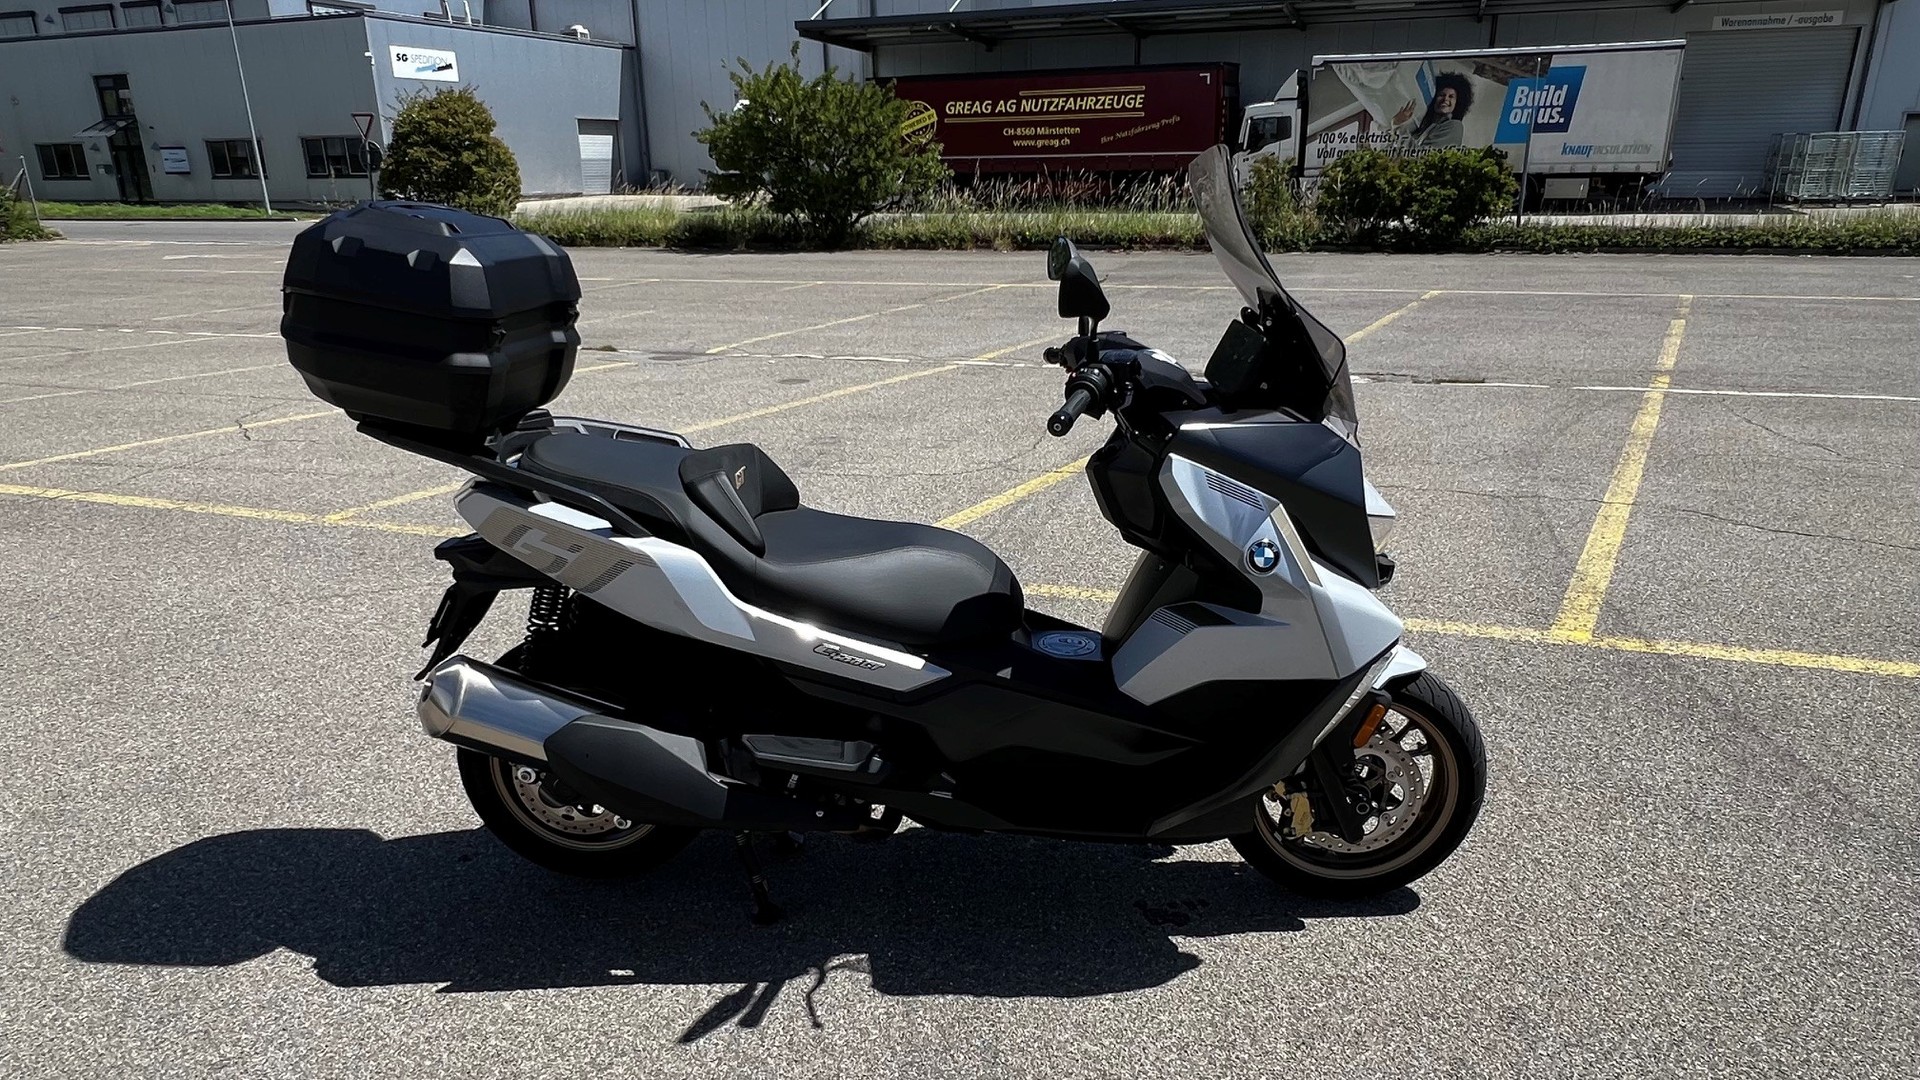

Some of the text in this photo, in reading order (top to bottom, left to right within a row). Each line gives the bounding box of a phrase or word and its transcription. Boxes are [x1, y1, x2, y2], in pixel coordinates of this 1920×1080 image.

[1721, 16, 1786, 27] Warenannahme
[1794, 12, 1834, 26] -ausgabe
[396, 52, 448, 65] SG SPEDITION
[1512, 84, 1569, 107] Build
[945, 100, 992, 115] GREAG
[996, 99, 1017, 114] AG
[1020, 94, 1145, 113] NUTZFAHRZEUGE
[1509, 105, 1565, 124] on us.
[1002, 126, 1081, 137] CH-8560 Märstetten
[1012, 137, 1071, 148] www.greag.ch
[1100, 135, 1114, 145] Ihre
[1318, 132, 1336, 144] 100
[1337, 132, 1348, 144] %
[1317, 147, 1336, 159] Voll
